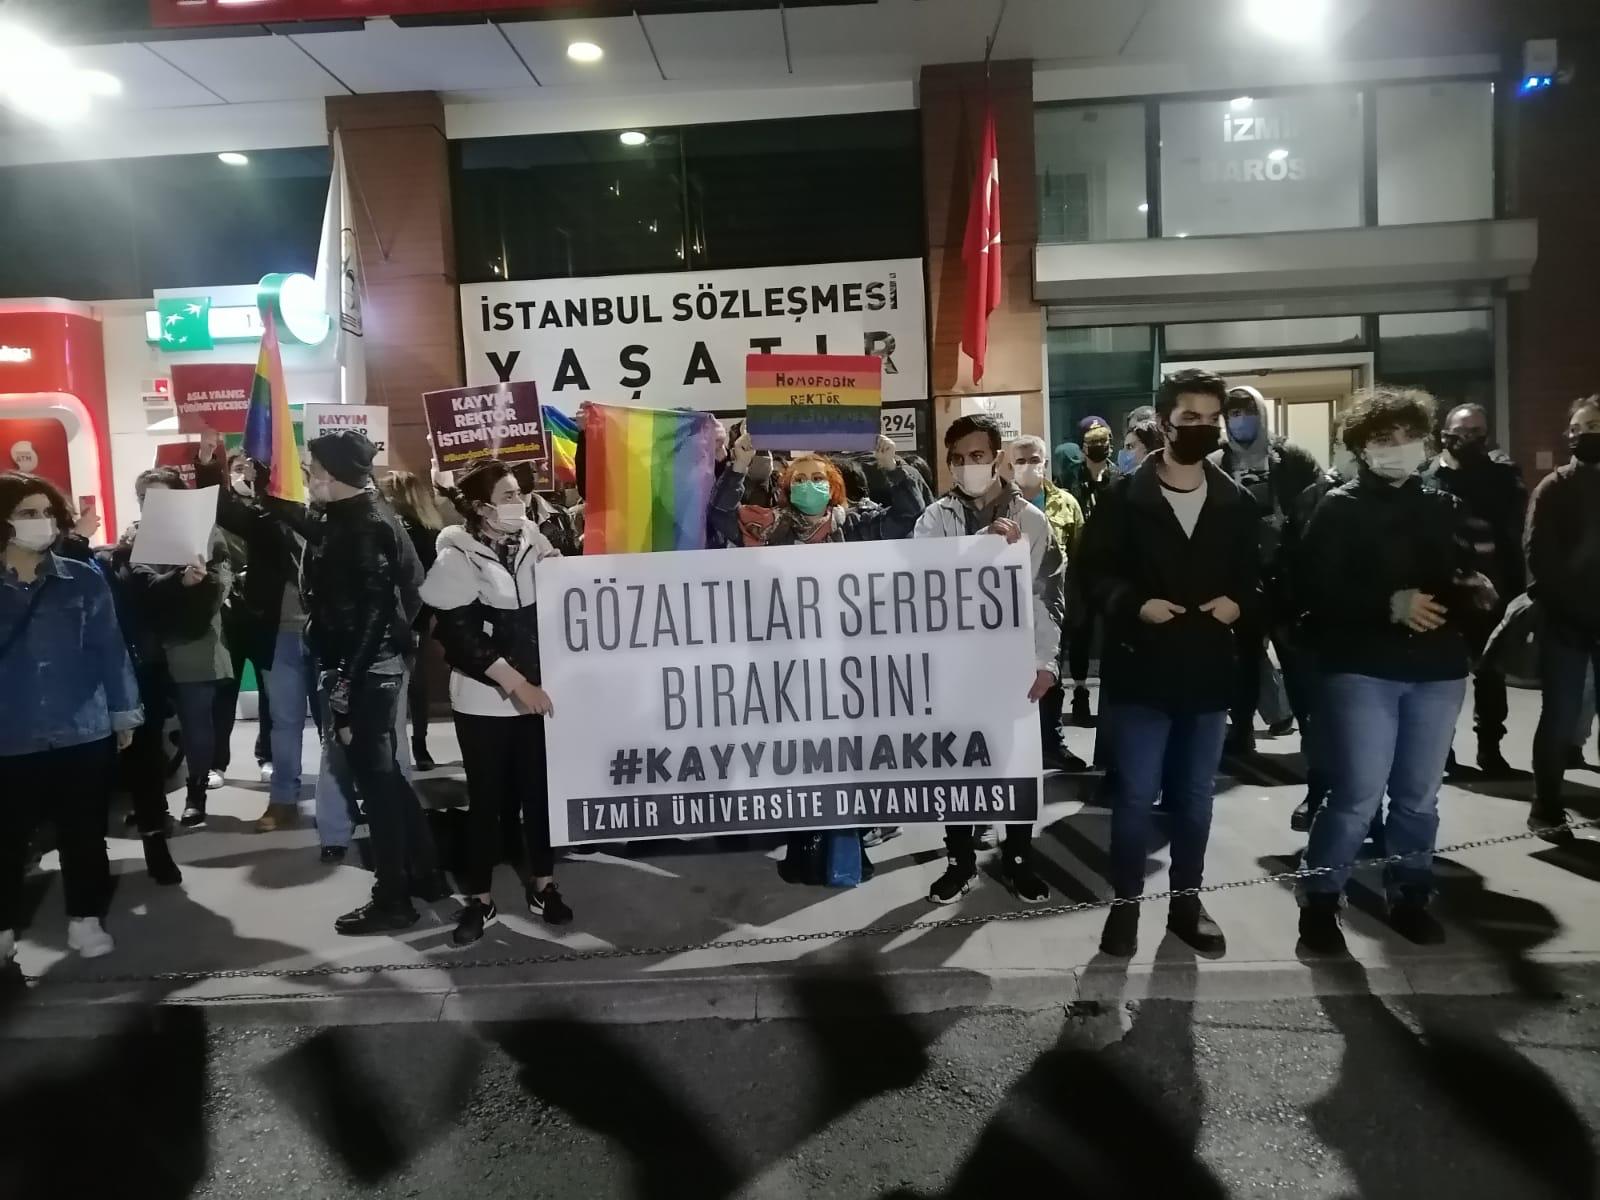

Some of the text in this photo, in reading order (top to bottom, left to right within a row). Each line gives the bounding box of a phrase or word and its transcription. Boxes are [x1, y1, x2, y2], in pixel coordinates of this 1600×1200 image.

[481, 273, 898, 331] İSTANBUL SÖZLEŞMESİ
[451, 391, 514, 411] KAYYIM
[790, 392, 840, 405] REKTÖR
[318, 414, 368, 425] KAYYIM
[454, 405, 517, 428] REKTÖR
[882, 414, 915, 432] 294
[437, 422, 539, 448] İSTEMİYORUZ
[564, 565, 1023, 652] GÖZALTILAR SERBEST
[662, 653, 932, 730] BIRAKILSIN!
[609, 731, 992, 785] #KAYYUMNAKKA
[582, 784, 1016, 831] İZMİR ÜNİVERSİTE DAYANIŞMASI
